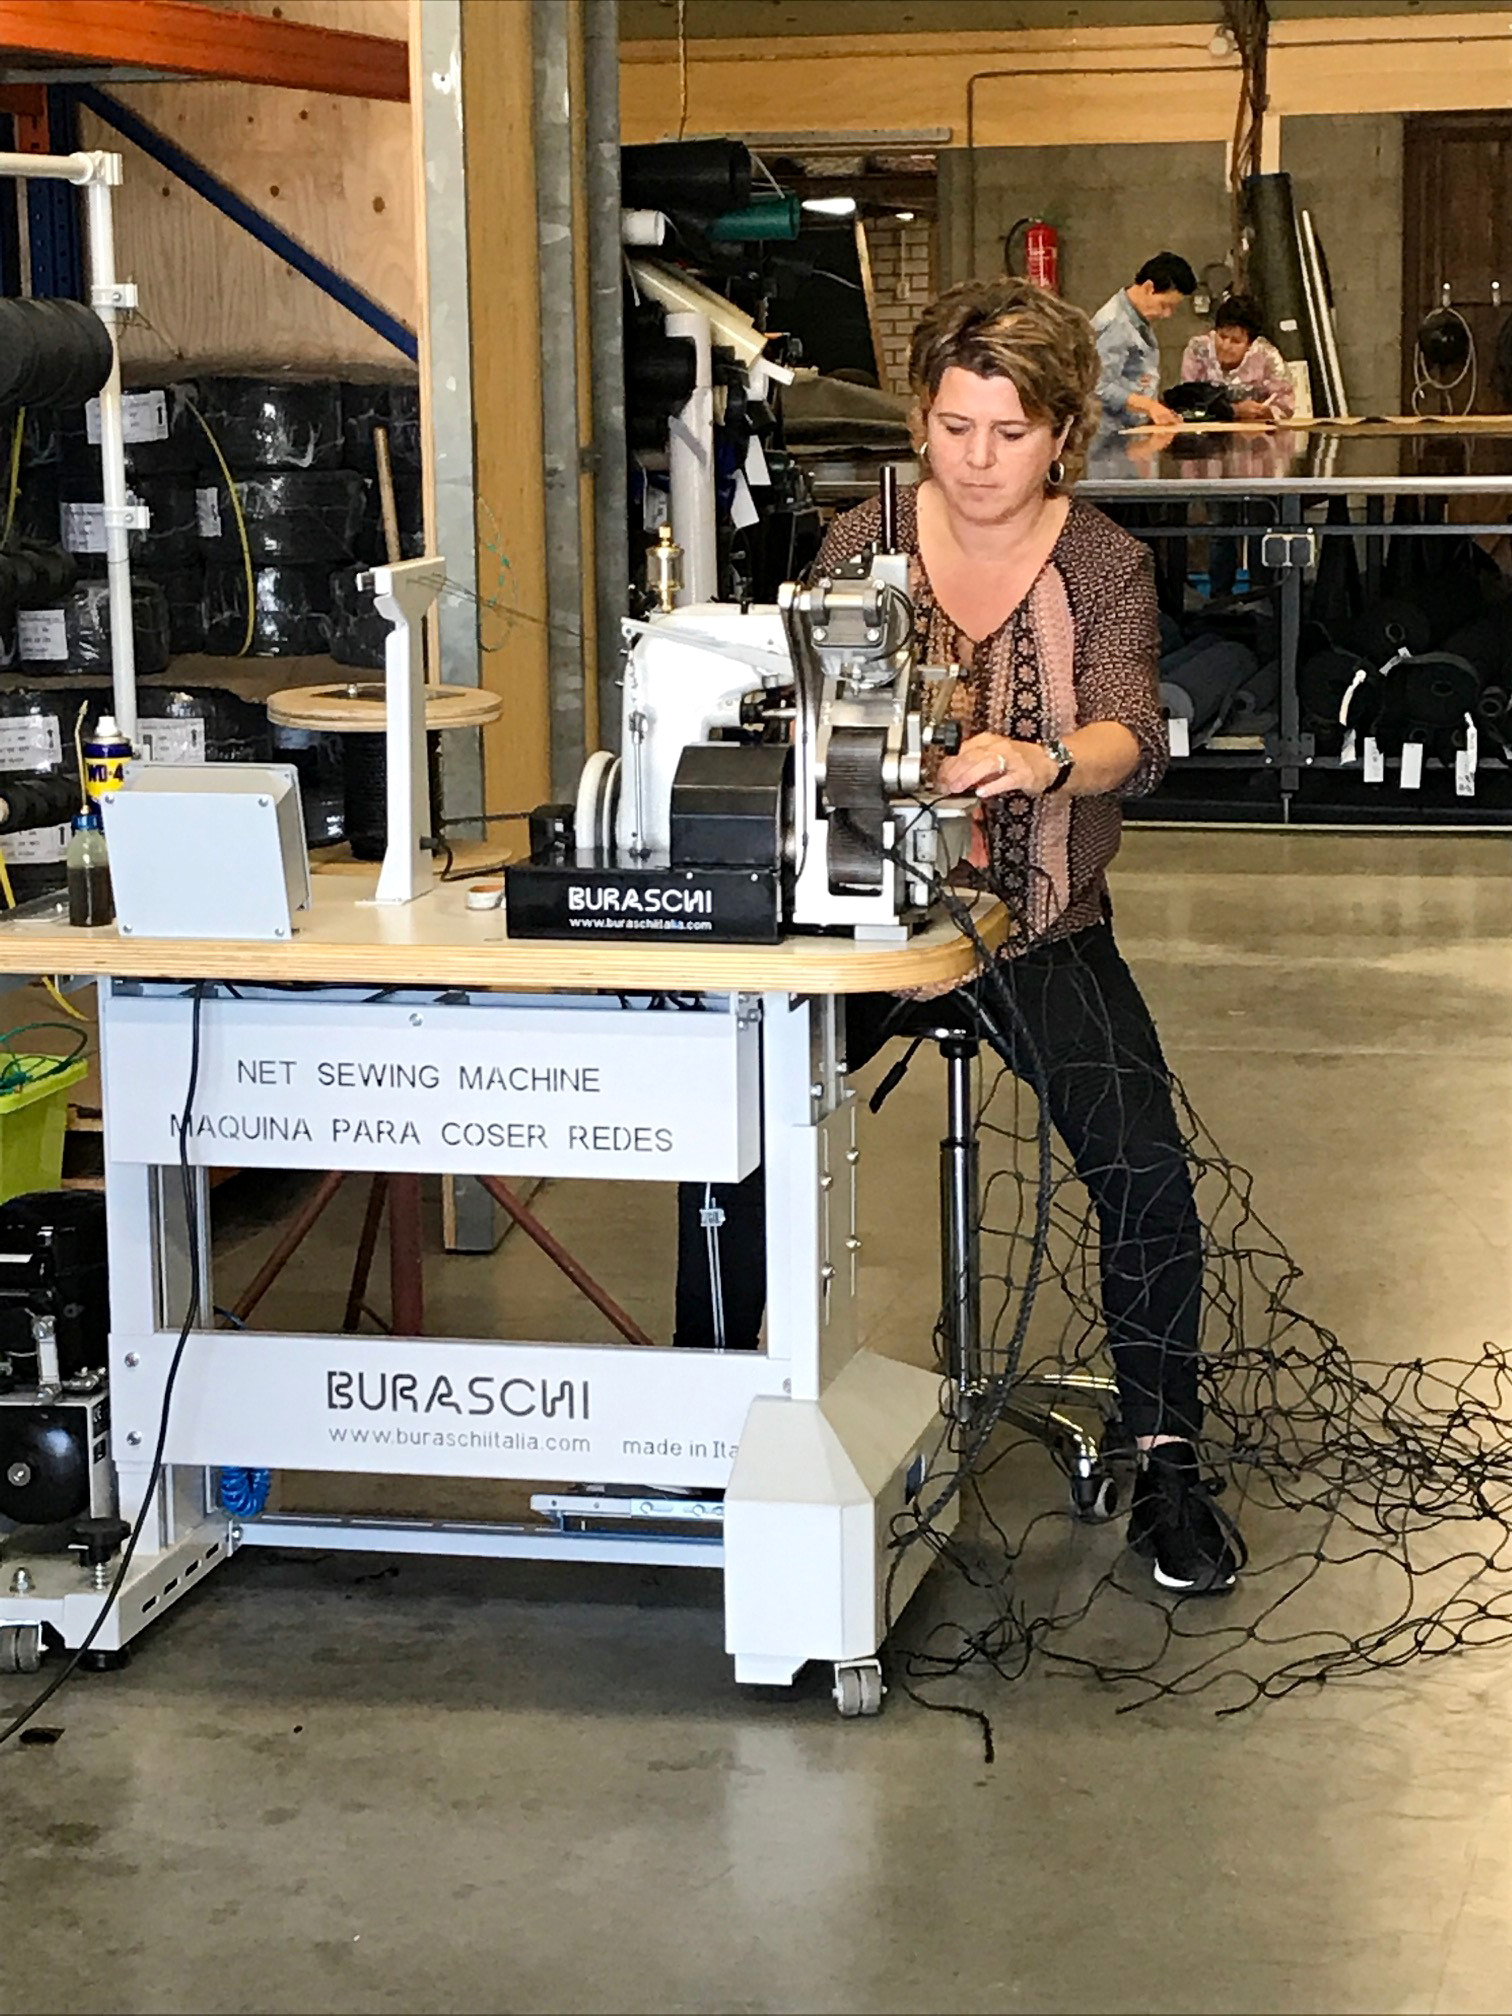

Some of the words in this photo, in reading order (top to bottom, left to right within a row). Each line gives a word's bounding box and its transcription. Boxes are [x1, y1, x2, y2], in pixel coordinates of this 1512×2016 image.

[87, 763, 124, 783] WD-4
[568, 886, 712, 913] BURASCHI
[237, 1059, 297, 1085] NET
[317, 1062, 440, 1089] SEWING
[459, 1065, 601, 1092] MACHINE
[170, 1113, 313, 1142] MAQUINA
[332, 1118, 421, 1145] PARA
[441, 1122, 548, 1149] COSER
[569, 1125, 674, 1152] REDES
[327, 1370, 590, 1420] BURASCHI
[328, 1426, 591, 1452] www.buraschiitalia.com
[622, 1438, 683, 1457] made
[689, 1440, 708, 1458] in
[712, 1440, 740, 1460] Ita
